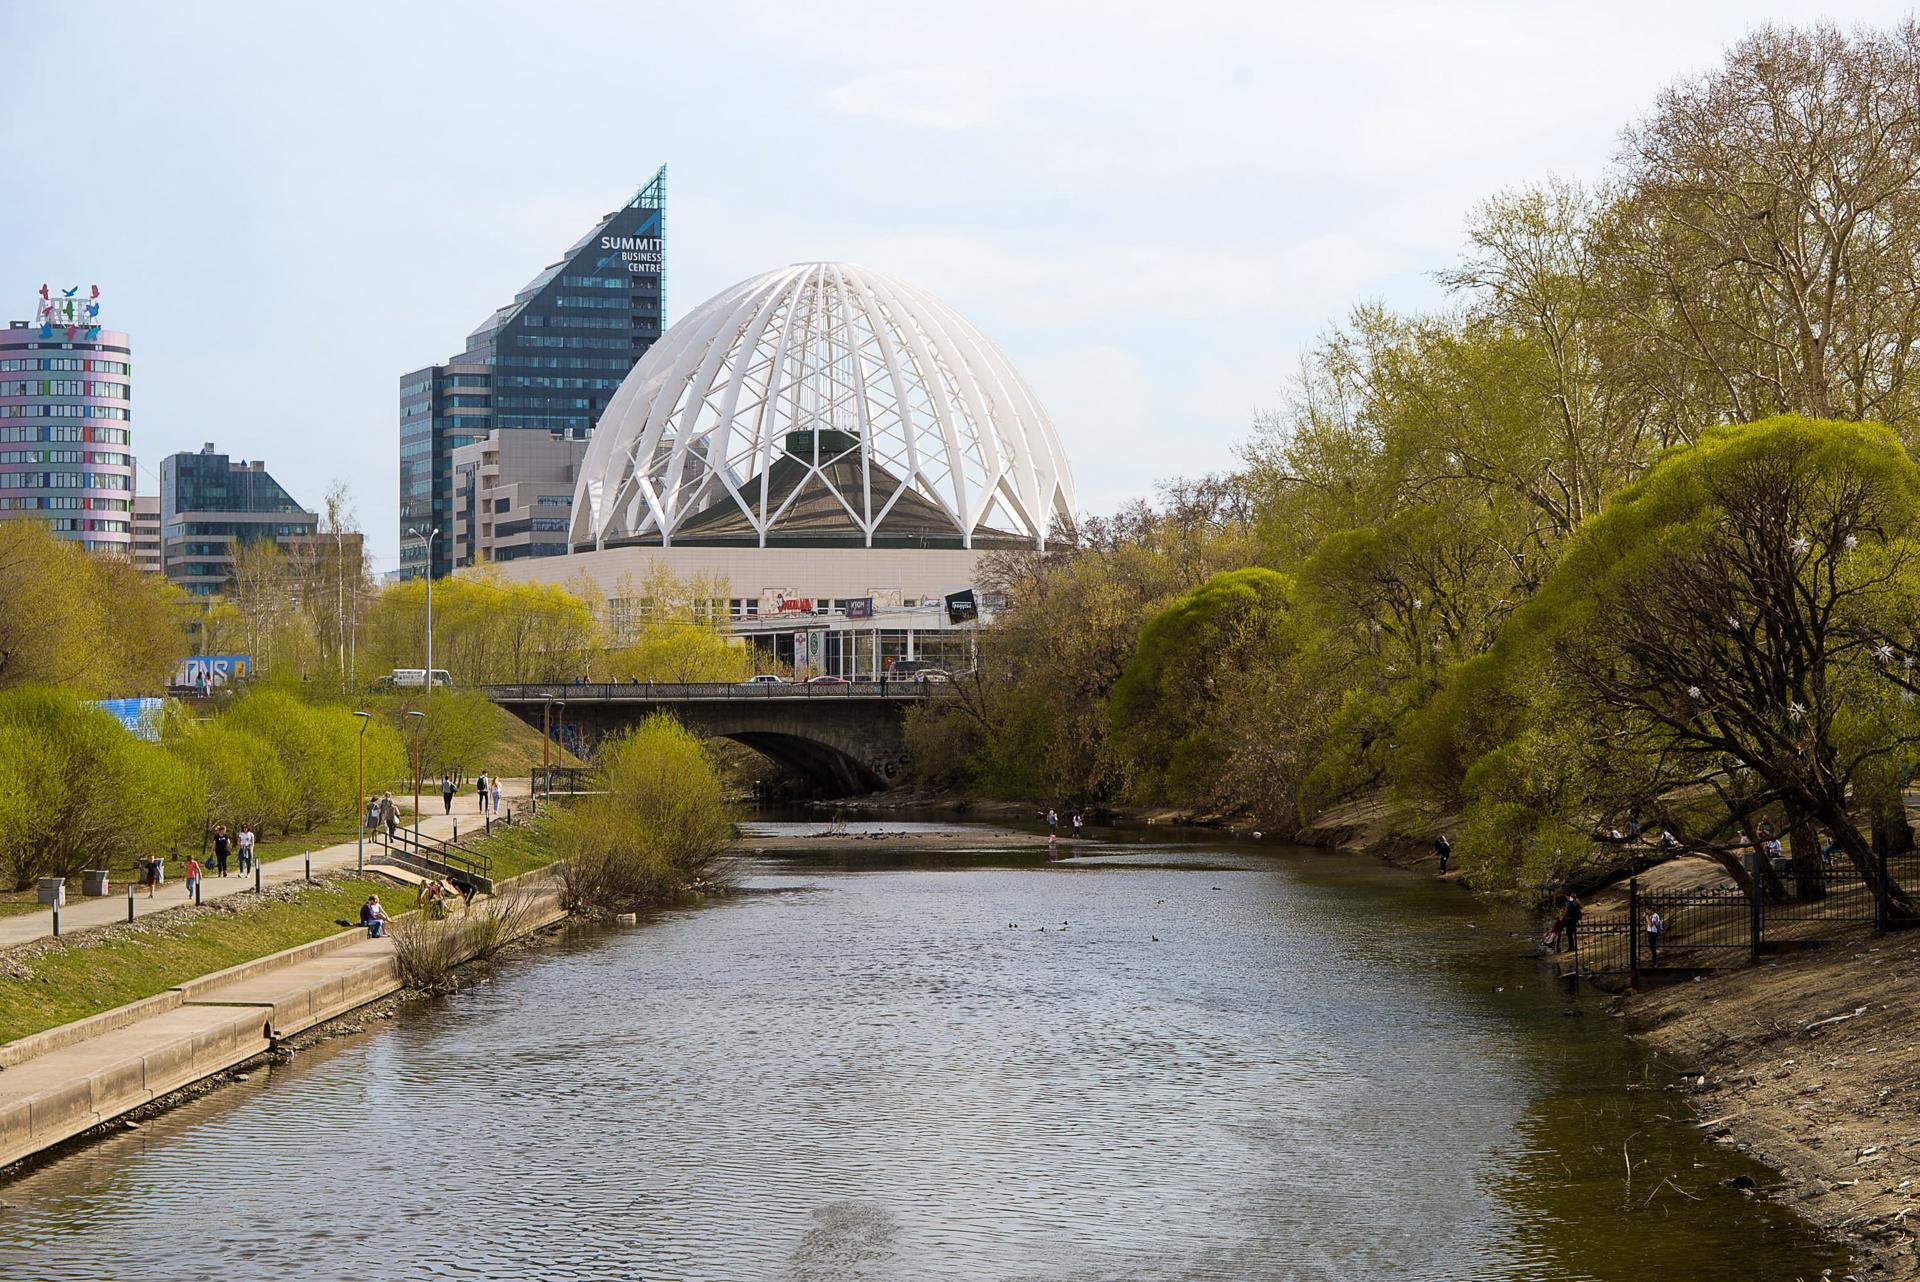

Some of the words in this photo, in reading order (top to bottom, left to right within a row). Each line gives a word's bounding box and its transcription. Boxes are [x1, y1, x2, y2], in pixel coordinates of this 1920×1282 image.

[601, 236, 662, 251] SUMMIT
[621, 251, 662, 262] BUSINESS
[628, 262, 661, 273] CENTRE
